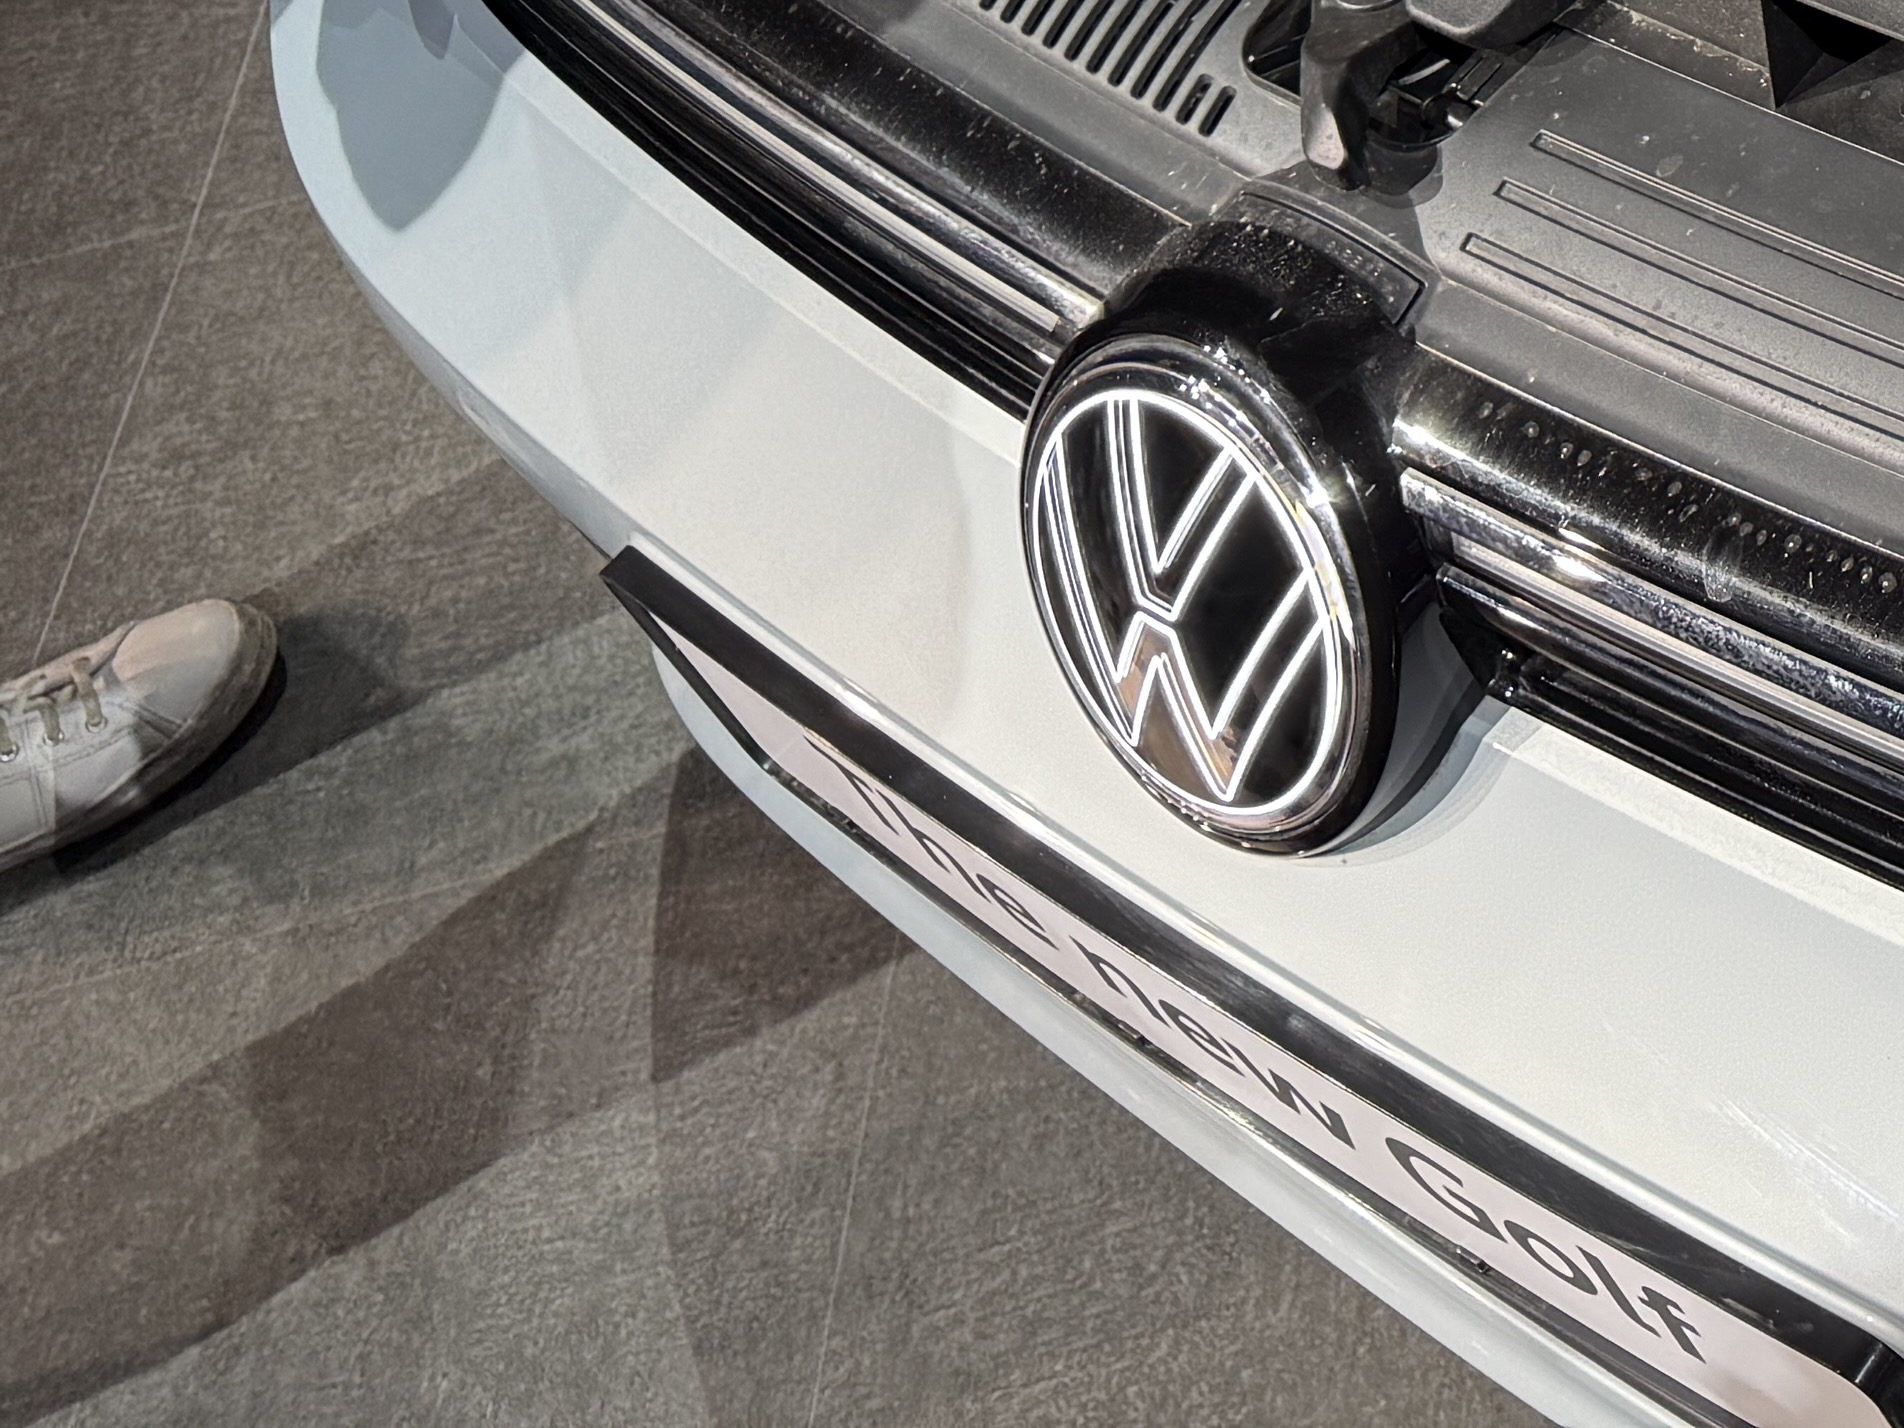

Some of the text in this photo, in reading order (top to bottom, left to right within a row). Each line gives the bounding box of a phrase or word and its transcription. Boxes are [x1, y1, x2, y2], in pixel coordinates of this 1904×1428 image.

[822, 755, 1708, 1364] The new Golf
